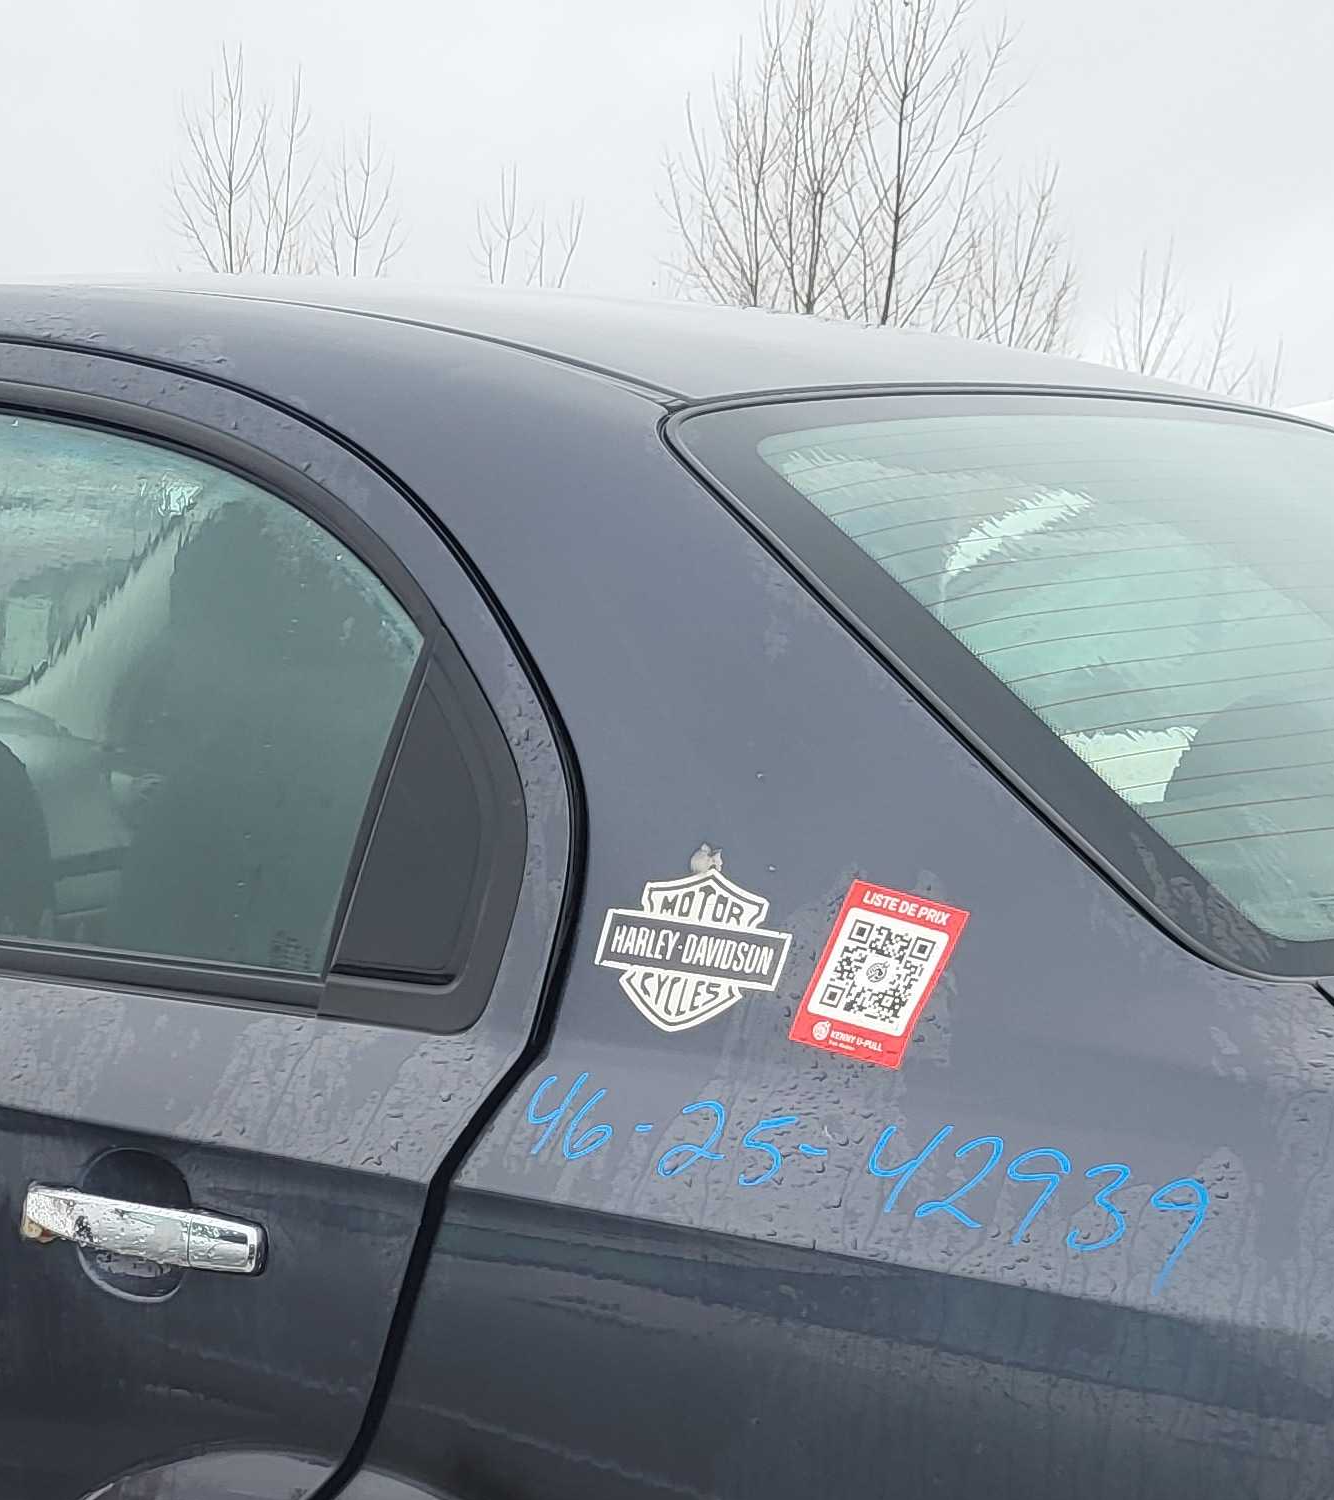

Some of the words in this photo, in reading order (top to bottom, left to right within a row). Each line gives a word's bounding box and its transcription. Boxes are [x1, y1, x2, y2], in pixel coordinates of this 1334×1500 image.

[660, 885, 745, 927] MOTOR
[862, 890, 901, 912] LISTE
[897, 900, 919, 917] DE
[916, 905, 951, 926] PRIX
[640, 971, 721, 1017] CYCLES
